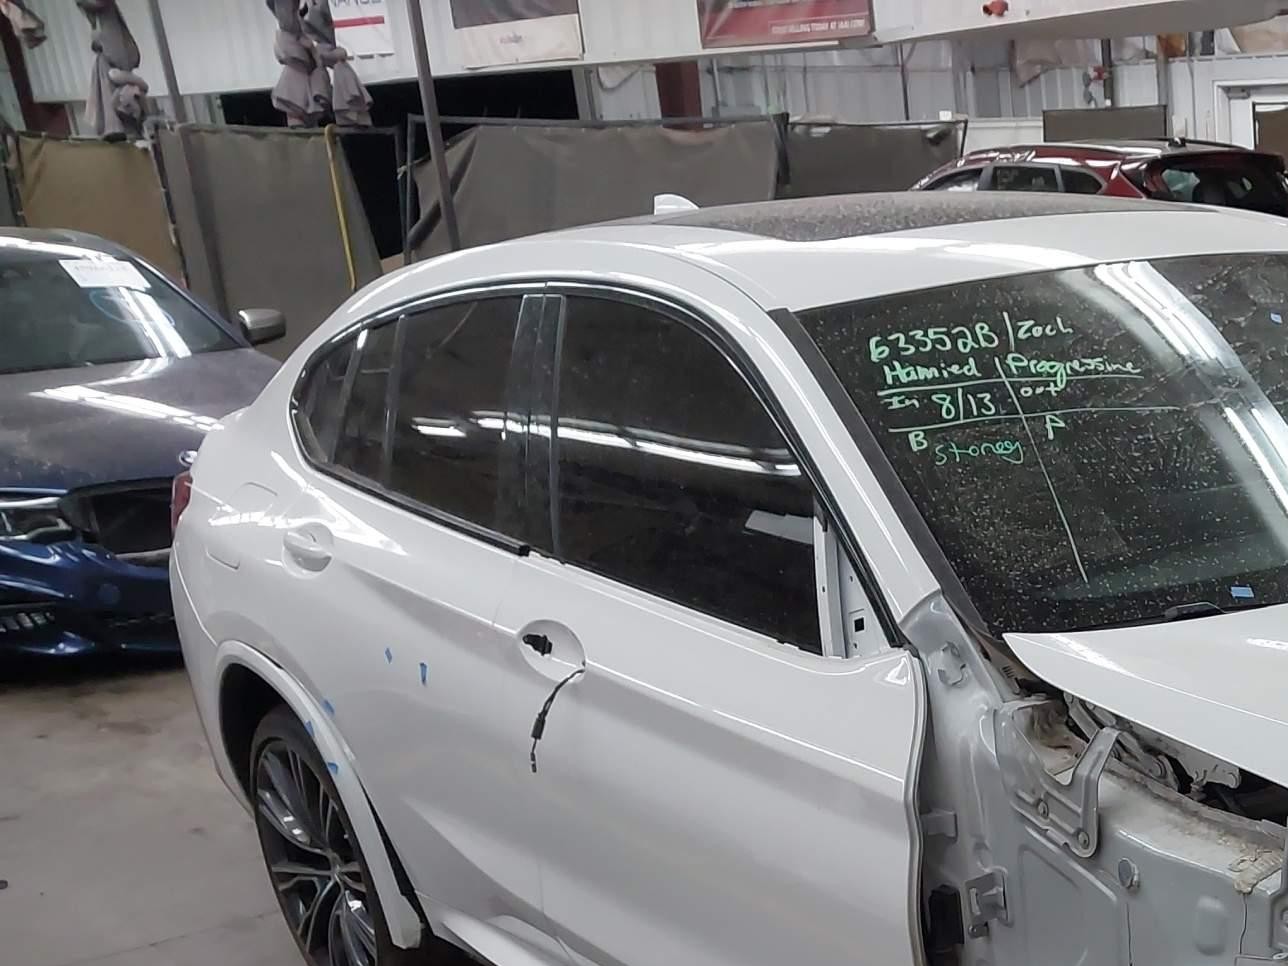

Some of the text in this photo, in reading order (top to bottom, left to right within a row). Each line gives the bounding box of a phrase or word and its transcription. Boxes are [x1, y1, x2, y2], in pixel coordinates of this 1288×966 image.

[869, 322, 999, 362] 63352B
[931, 387, 996, 423] 8/13
[908, 431, 928, 452] B
